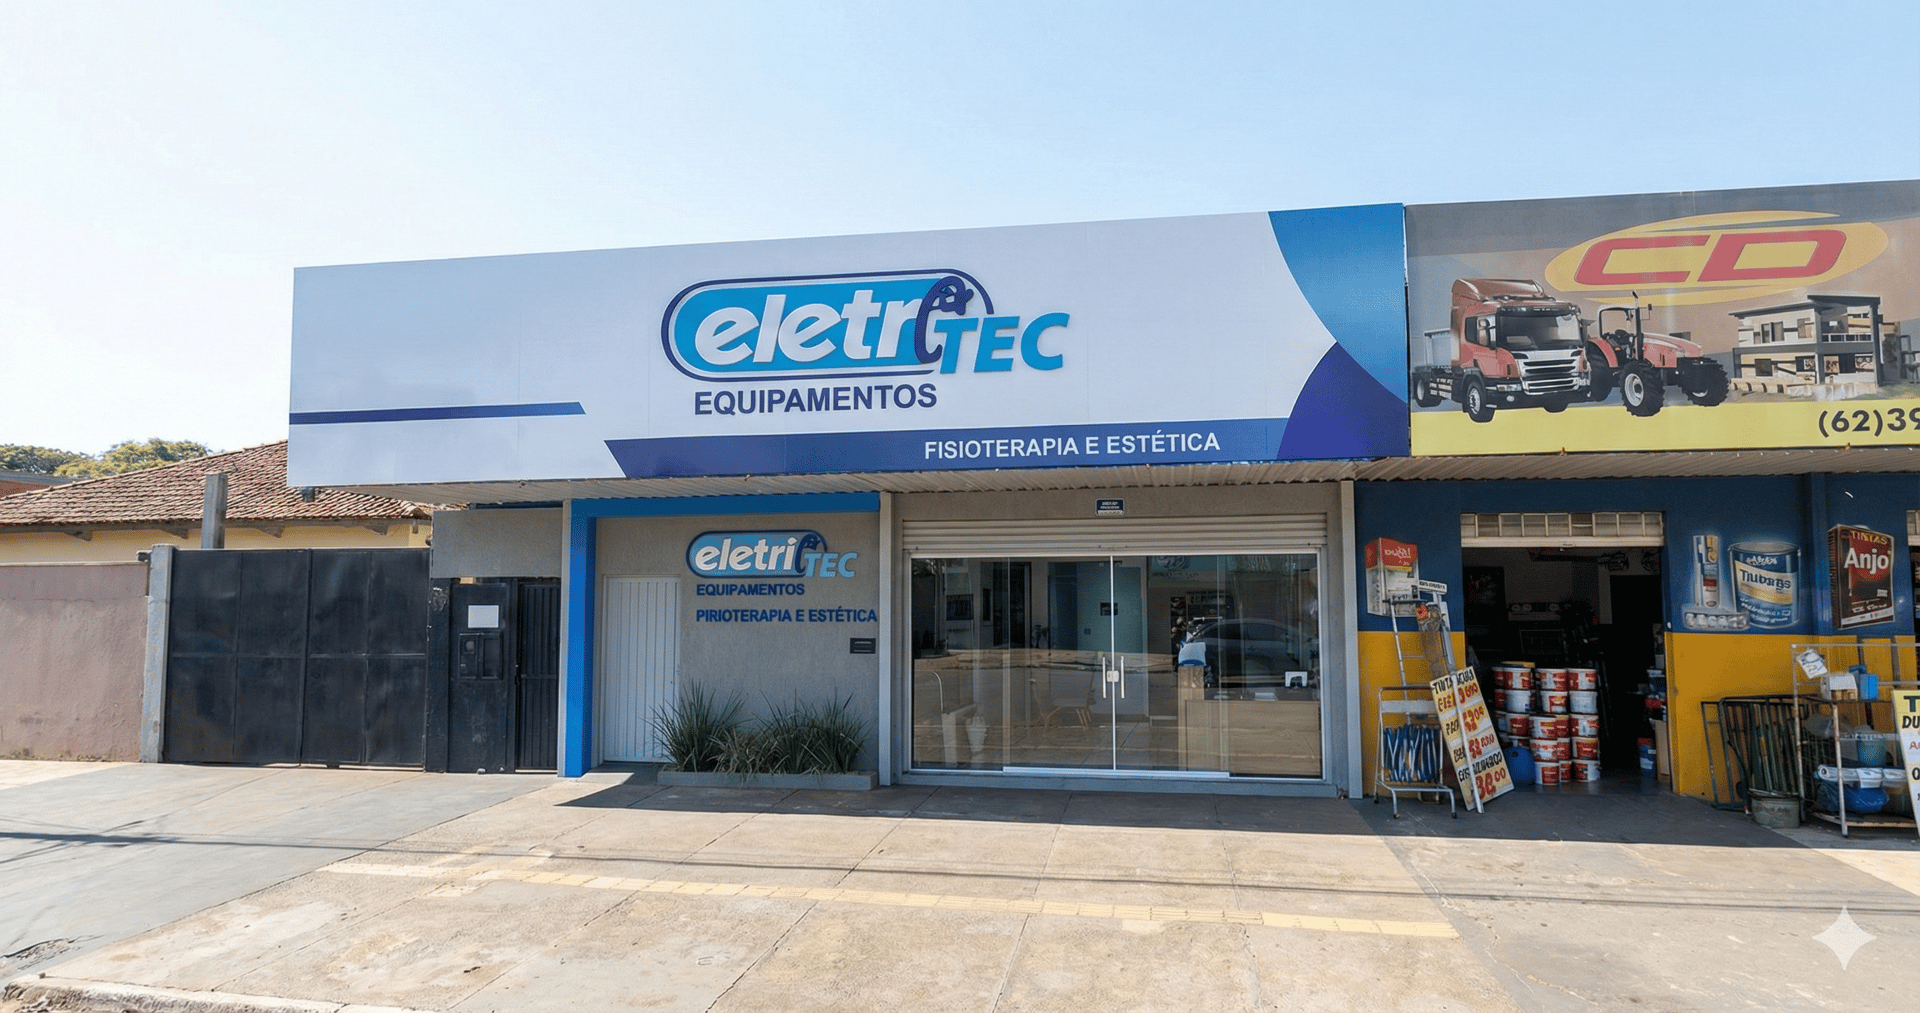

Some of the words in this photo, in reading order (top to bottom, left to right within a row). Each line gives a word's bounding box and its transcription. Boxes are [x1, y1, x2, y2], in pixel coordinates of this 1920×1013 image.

[1574, 229, 1847, 285] CD
[694, 382, 937, 416] EQUIPAMENTOS
[924, 436, 1079, 460] FISIOTERAPIA
[1085, 436, 1100, 455] E
[1106, 430, 1221, 454] ESTÉTICA
[1843, 547, 1889, 575] Anjo
[696, 583, 806, 597] EQUIPAMENTOS
[696, 608, 793, 623] PIRIOTERAPIA
[795, 609, 806, 622] E
[807, 605, 878, 623] ESTÉTICA
